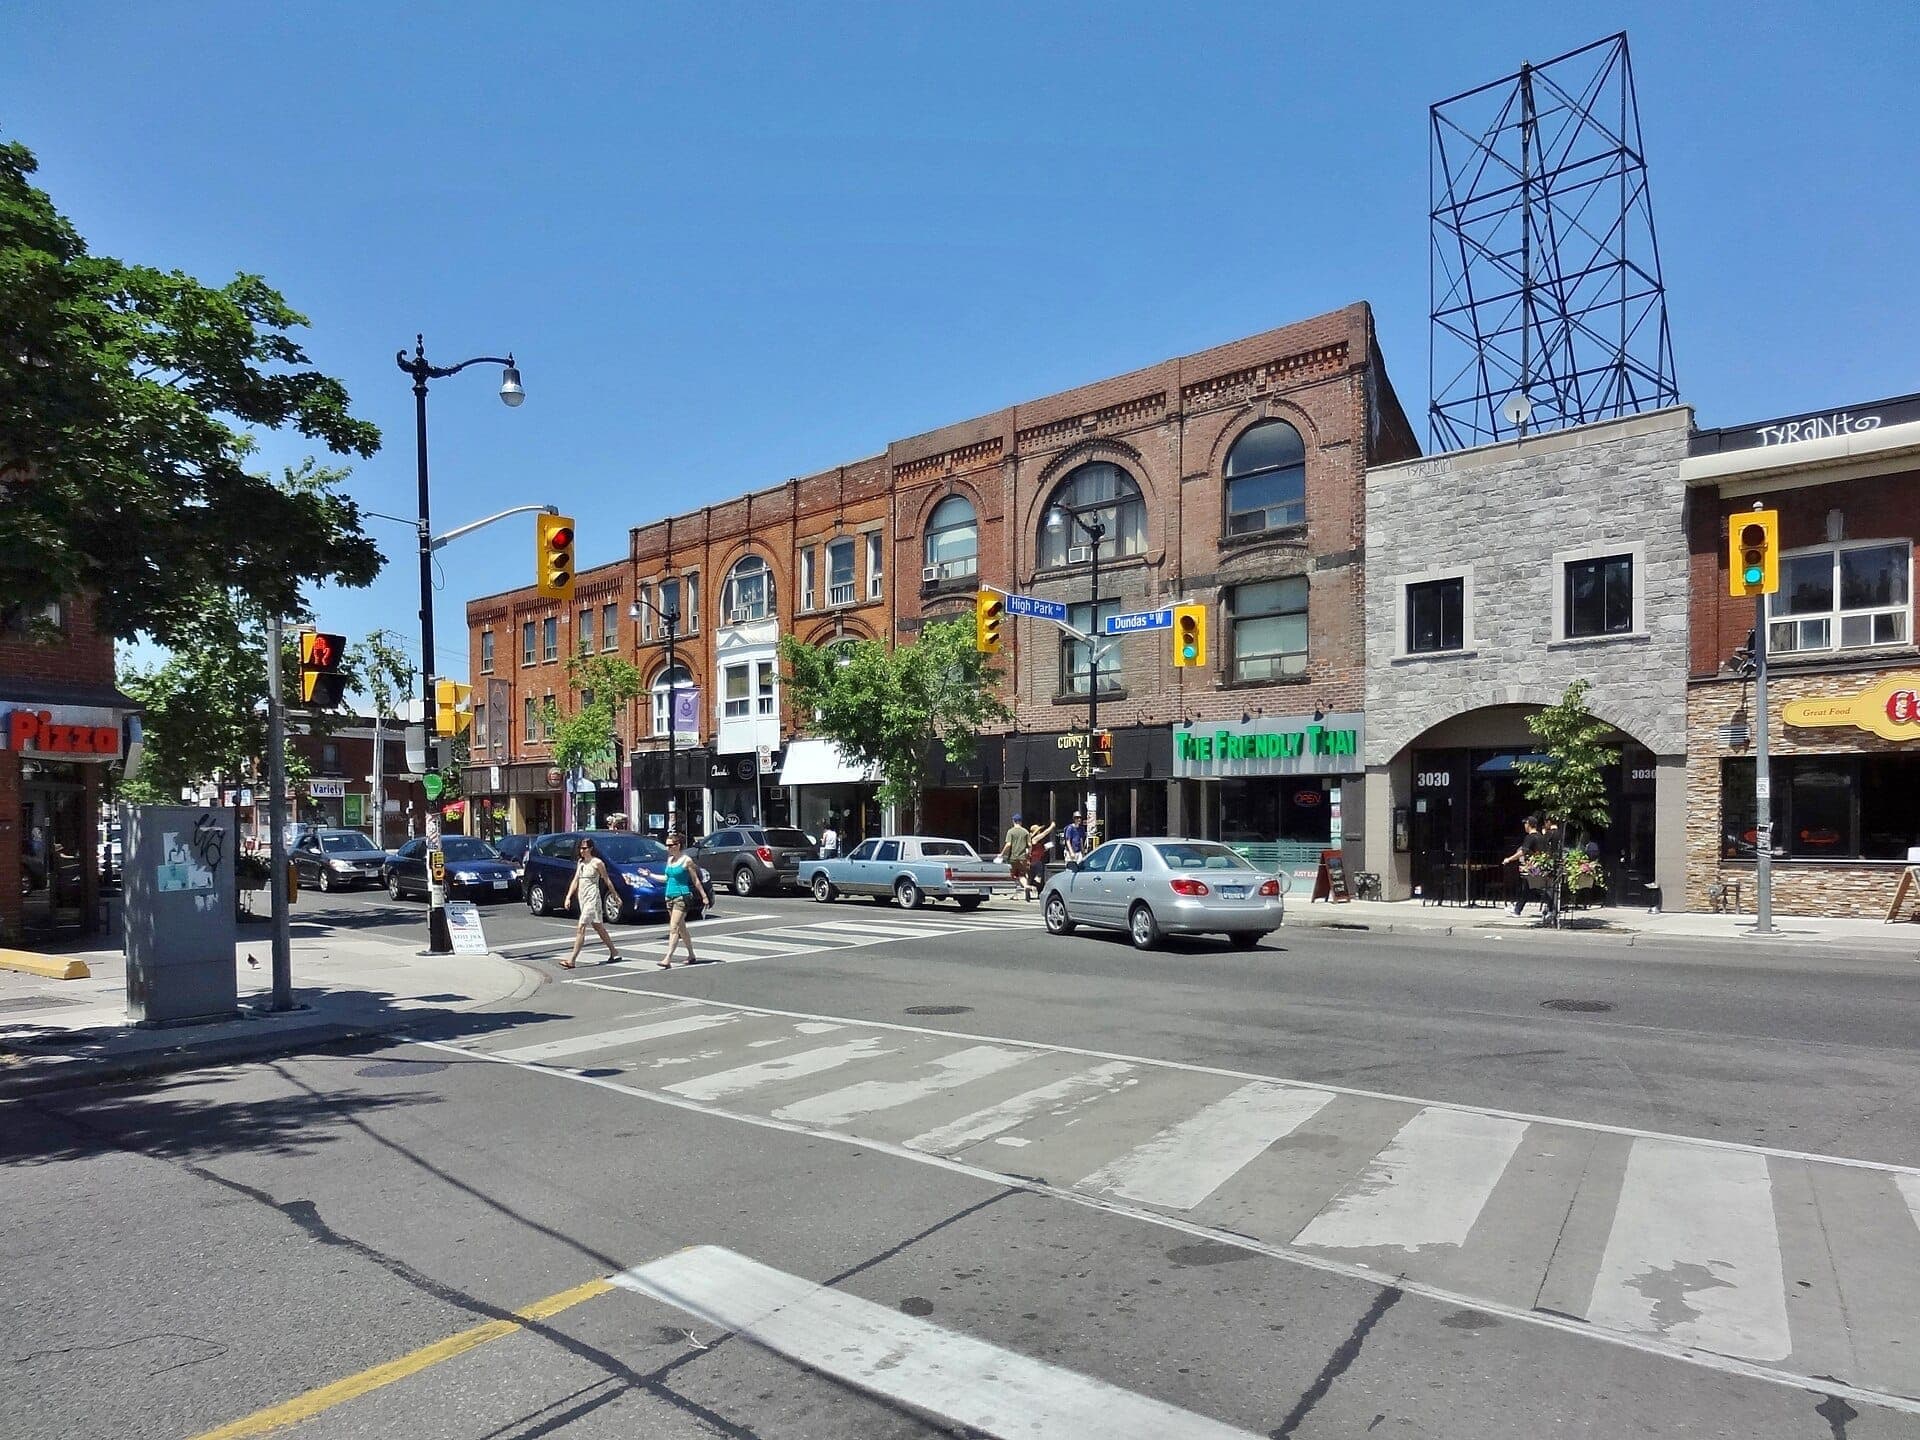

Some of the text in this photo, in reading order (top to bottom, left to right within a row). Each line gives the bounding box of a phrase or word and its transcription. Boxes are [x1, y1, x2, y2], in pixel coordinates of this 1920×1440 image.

[1011, 597, 1031, 614] High
[1034, 603, 1053, 616] Park
[1114, 614, 1147, 630] Dundas
[1155, 612, 1164, 625] W
[1802, 706, 1852, 717] Great Food
[10, 709, 118, 754] Pizza
[1175, 725, 1357, 761] THE FRIENDLY THAI
[1417, 772, 1450, 787] 3030
[313, 783, 343, 795] Variety
